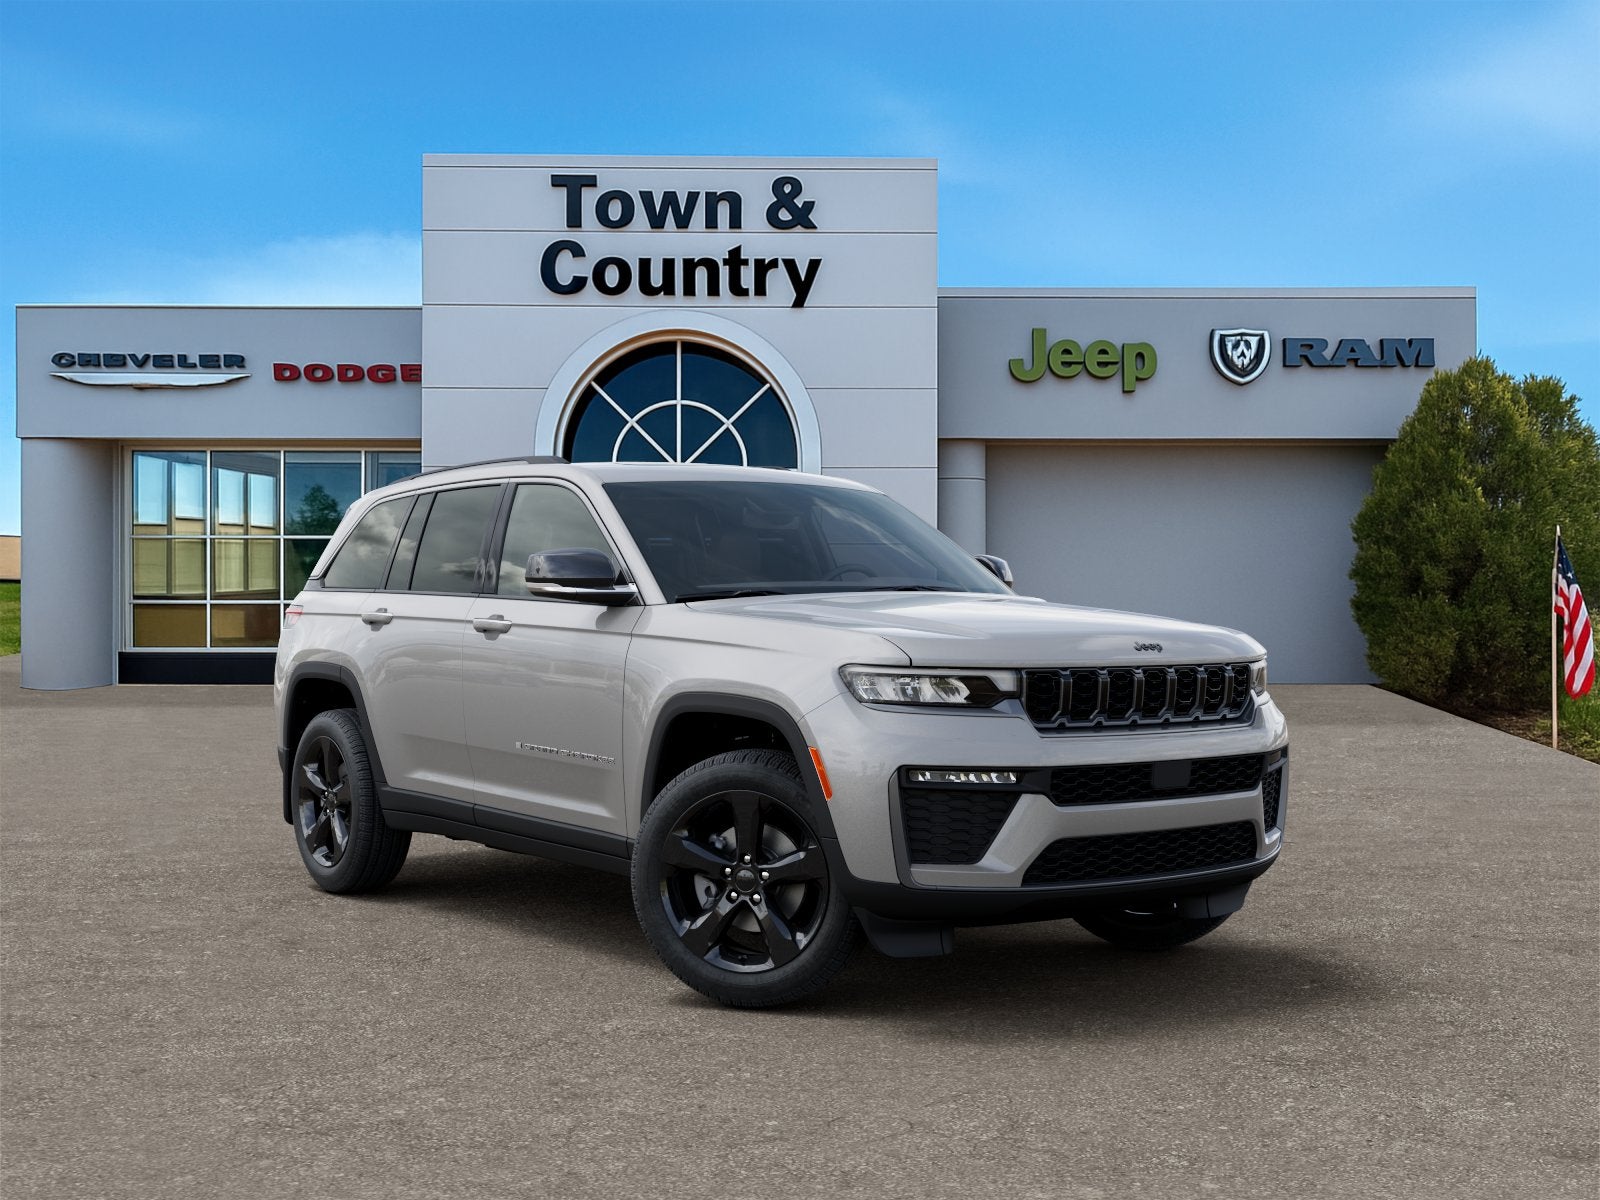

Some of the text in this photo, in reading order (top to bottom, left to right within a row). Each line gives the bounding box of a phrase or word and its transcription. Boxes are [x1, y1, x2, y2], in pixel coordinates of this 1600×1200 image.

[550, 174, 818, 230] Town &
[540, 239, 822, 308] Country
[273, 363, 422, 383] DODGE
[1009, 328, 1157, 392] Jeep
[1282, 337, 1435, 368] RAM
[1133, 641, 1163, 653] Jeep
